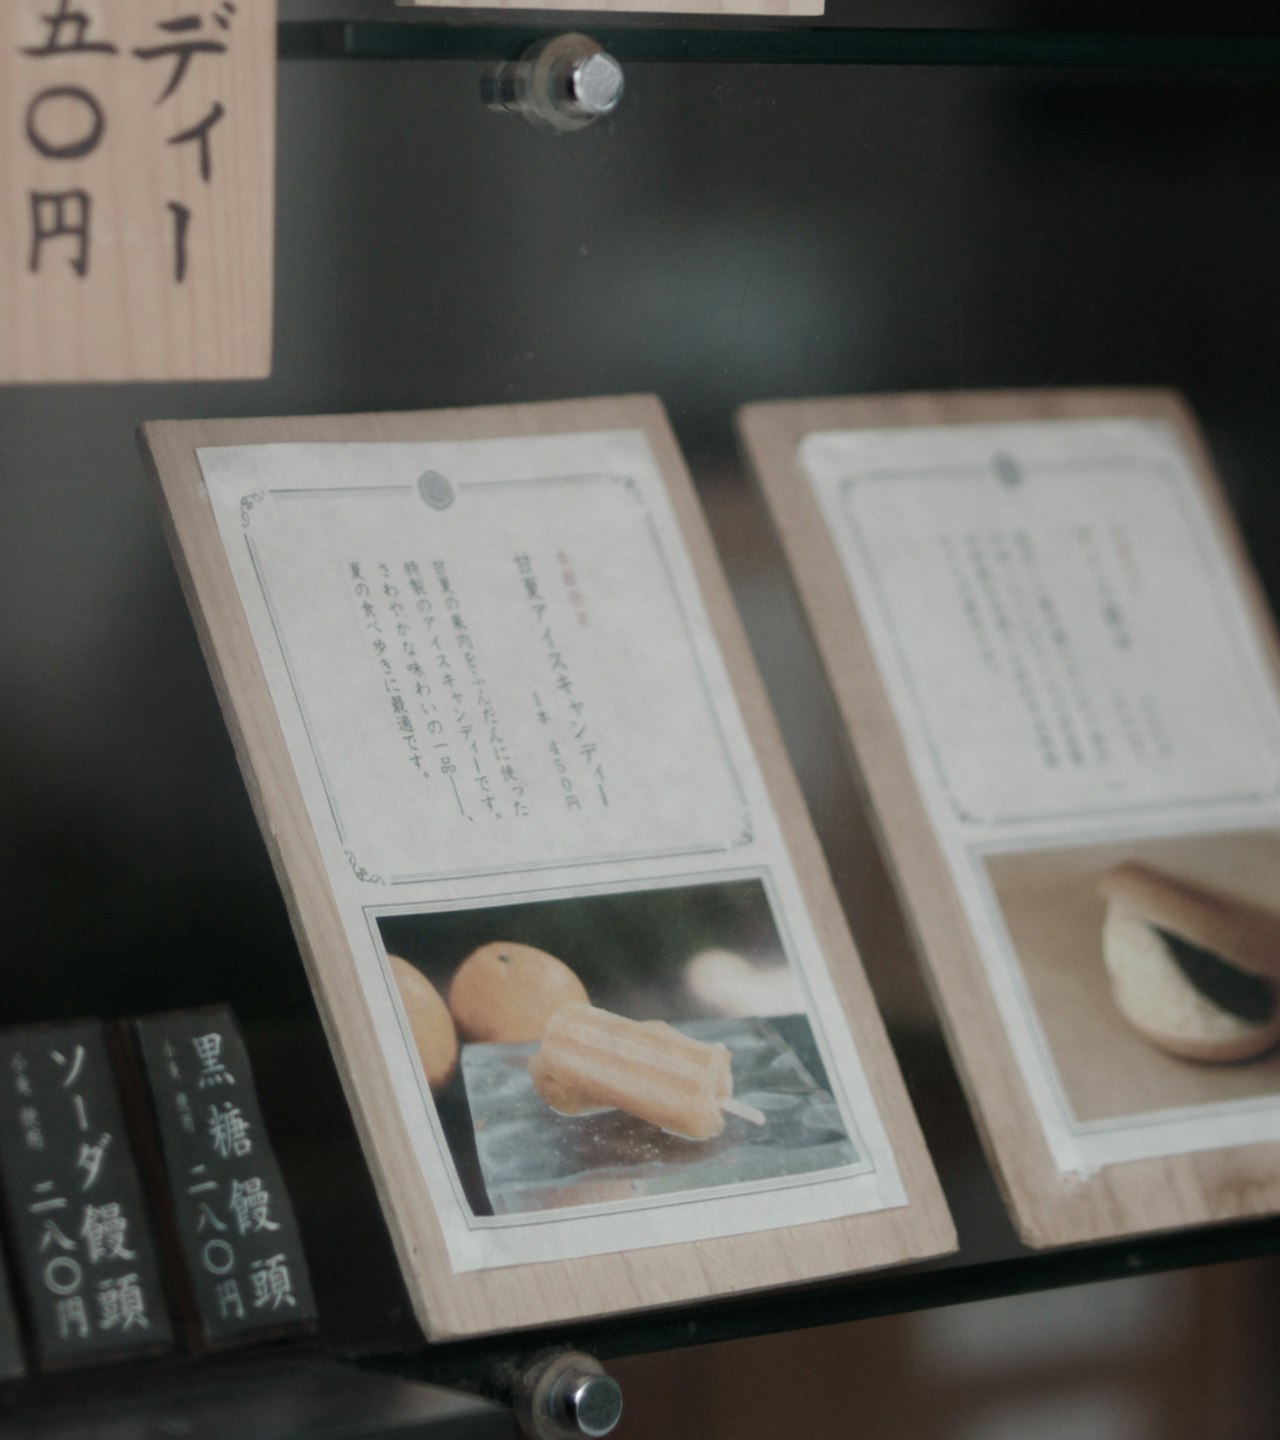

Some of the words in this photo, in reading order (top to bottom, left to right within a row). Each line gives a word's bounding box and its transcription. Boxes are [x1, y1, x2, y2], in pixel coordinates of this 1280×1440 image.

[348, 561, 431, 778] 夏の食べ歩きに最適です。
[512, 550, 609, 807] 甘夏アイスキャンディー
[28, 1180, 90, 1339] 二八〇円
[49, 1044, 150, 1333] ソーダ饅頭
[186, 1163, 246, 1320] 二八〇円
[191, 1031, 298, 1312] 黒糖饅頭
